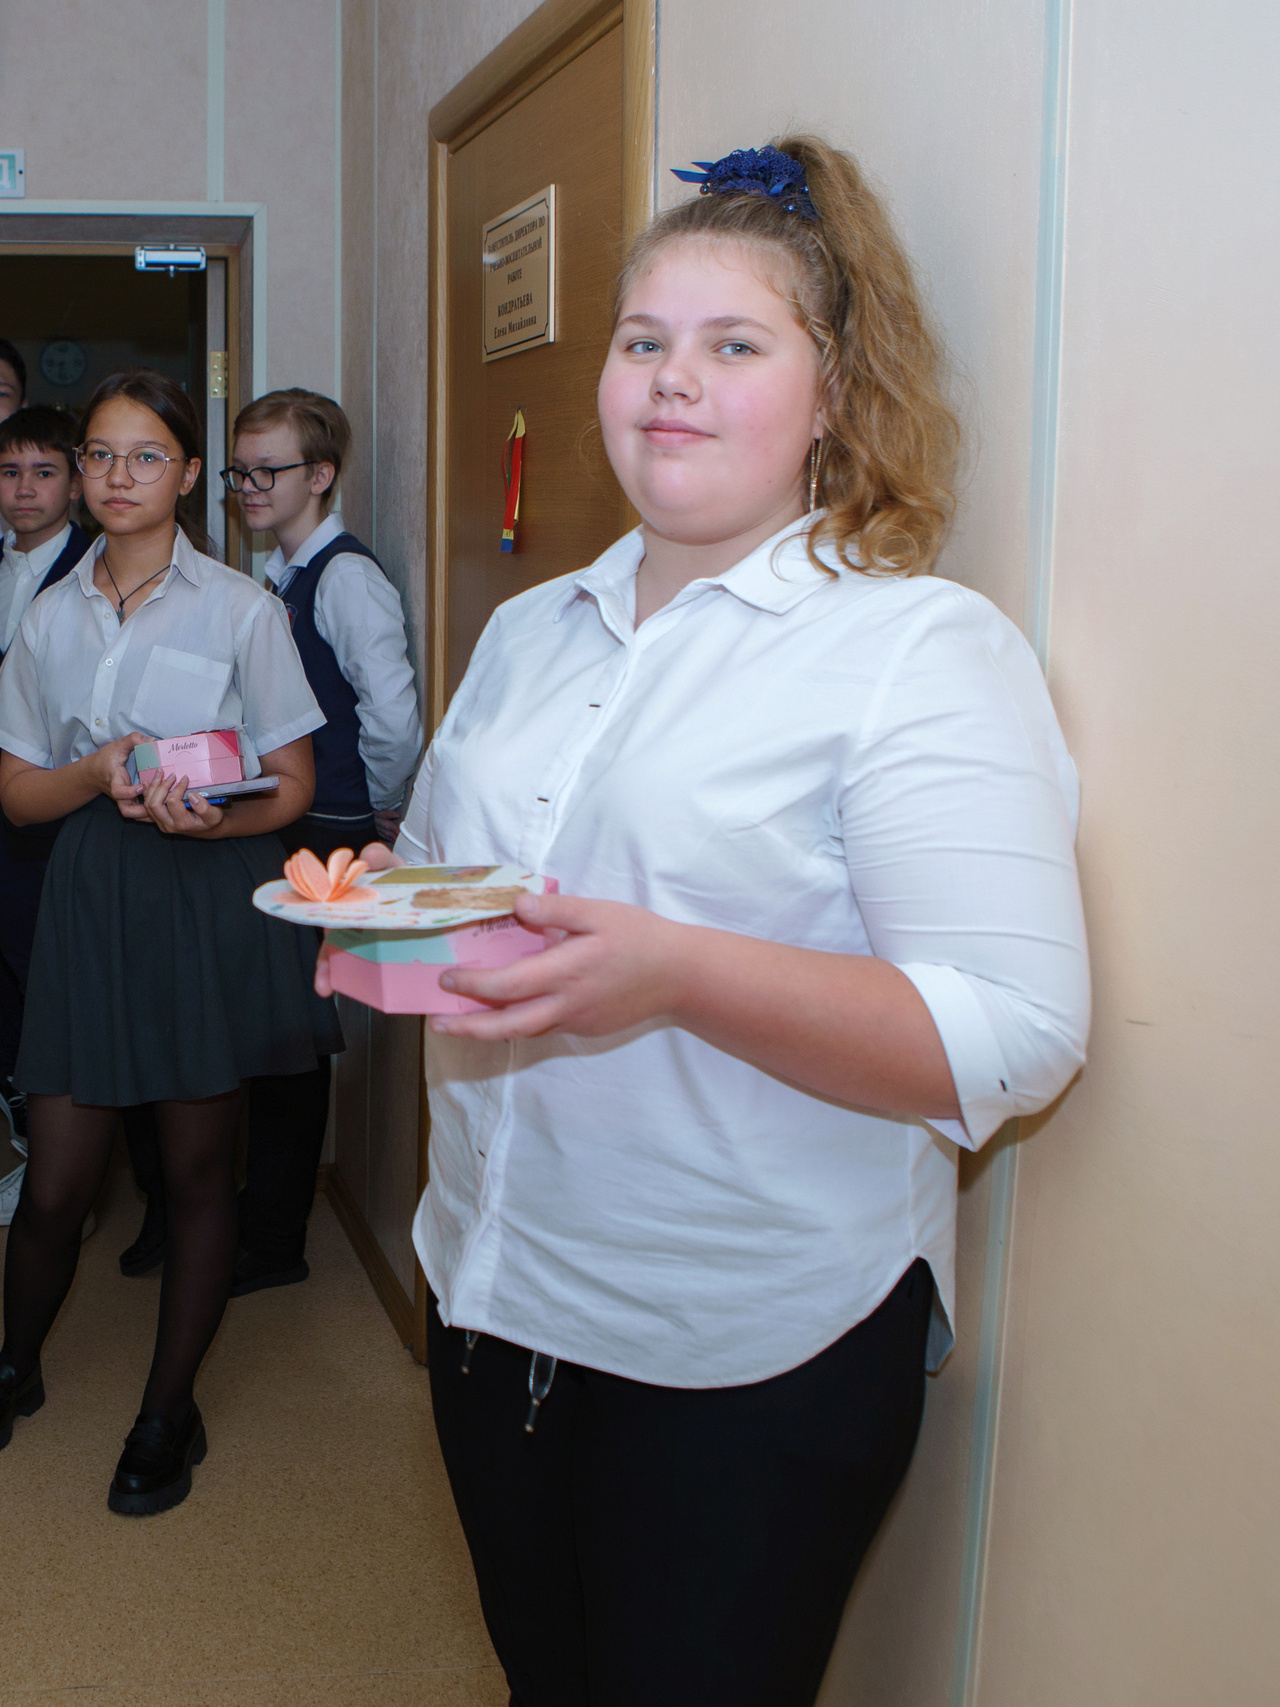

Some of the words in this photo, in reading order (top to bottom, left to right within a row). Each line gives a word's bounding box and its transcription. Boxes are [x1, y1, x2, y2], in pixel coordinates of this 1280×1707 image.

[514, 219, 538, 241] ДИРЕКТОРА
[538, 215, 546, 228] ПО
[507, 268, 523, 284] РАБОТЕ
[498, 293, 533, 317] КОНДРАТЬЕВА
[494, 326, 507, 339] Елена
[508, 315, 537, 335] Михайловна
[168, 742, 198, 753] Merletto
